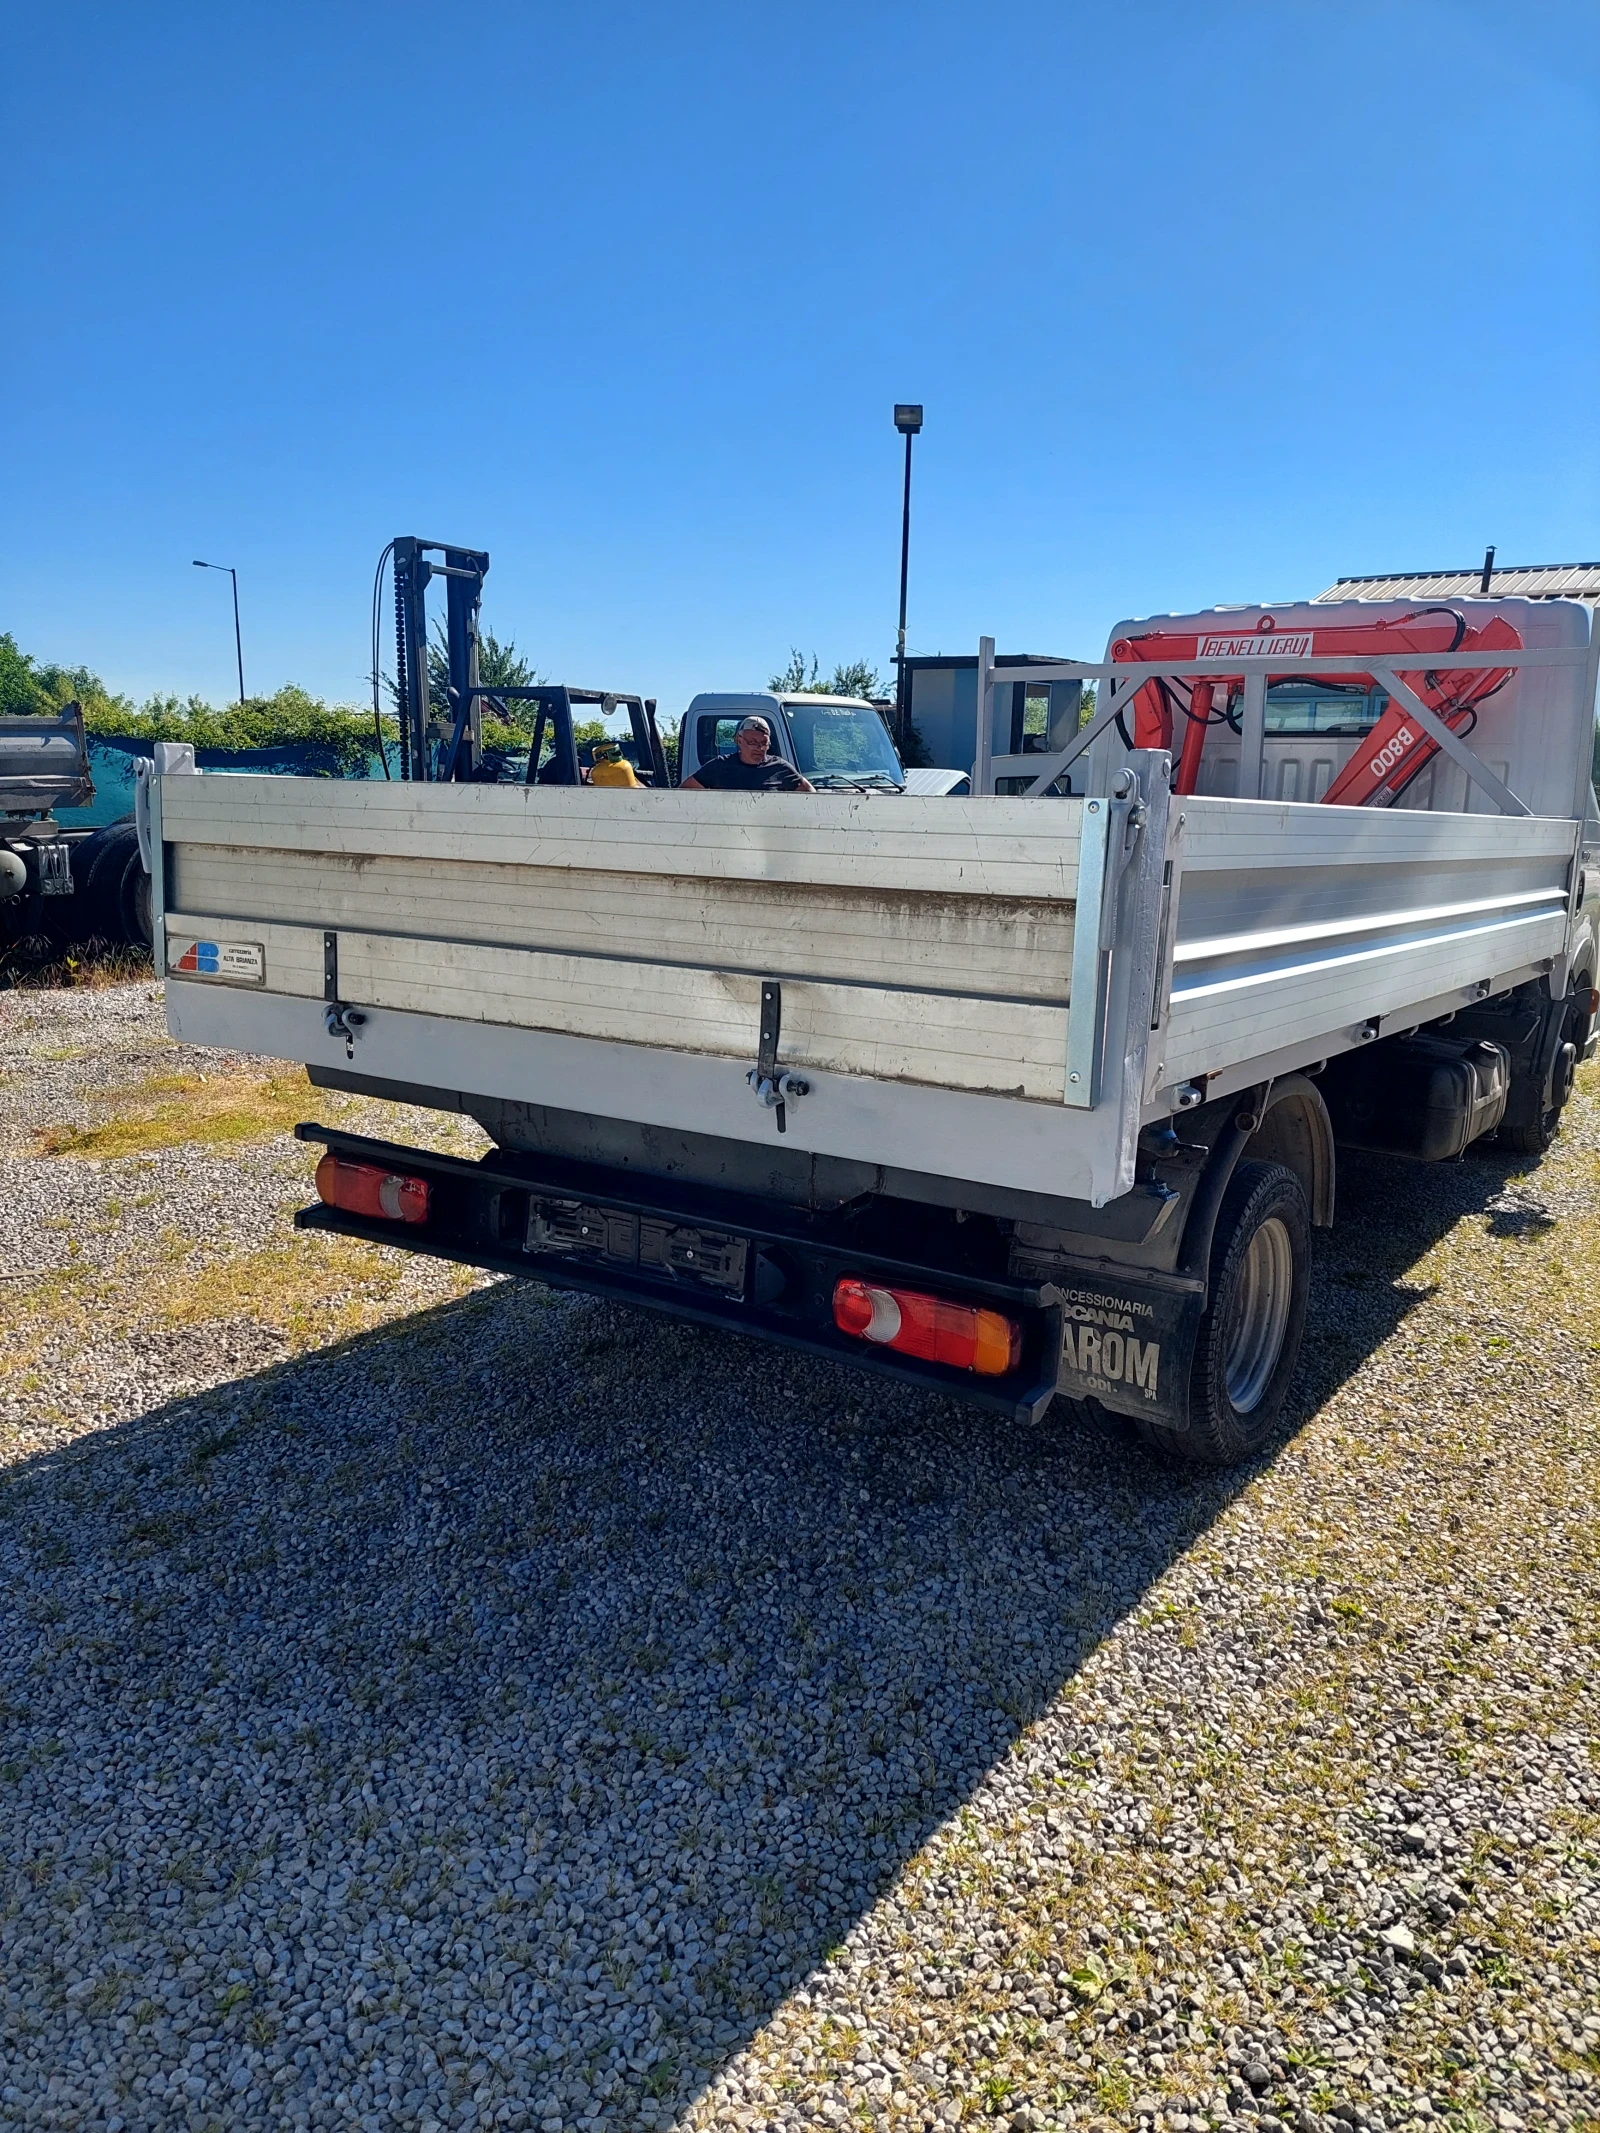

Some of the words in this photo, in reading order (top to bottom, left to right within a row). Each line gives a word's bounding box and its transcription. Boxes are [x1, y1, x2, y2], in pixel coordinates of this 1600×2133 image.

[1370, 726, 1415, 777] B800
[222, 955, 235, 963] ALTA
[235, 956, 259, 966] BRIANZA
[1144, 1388, 1157, 1402] SPA
